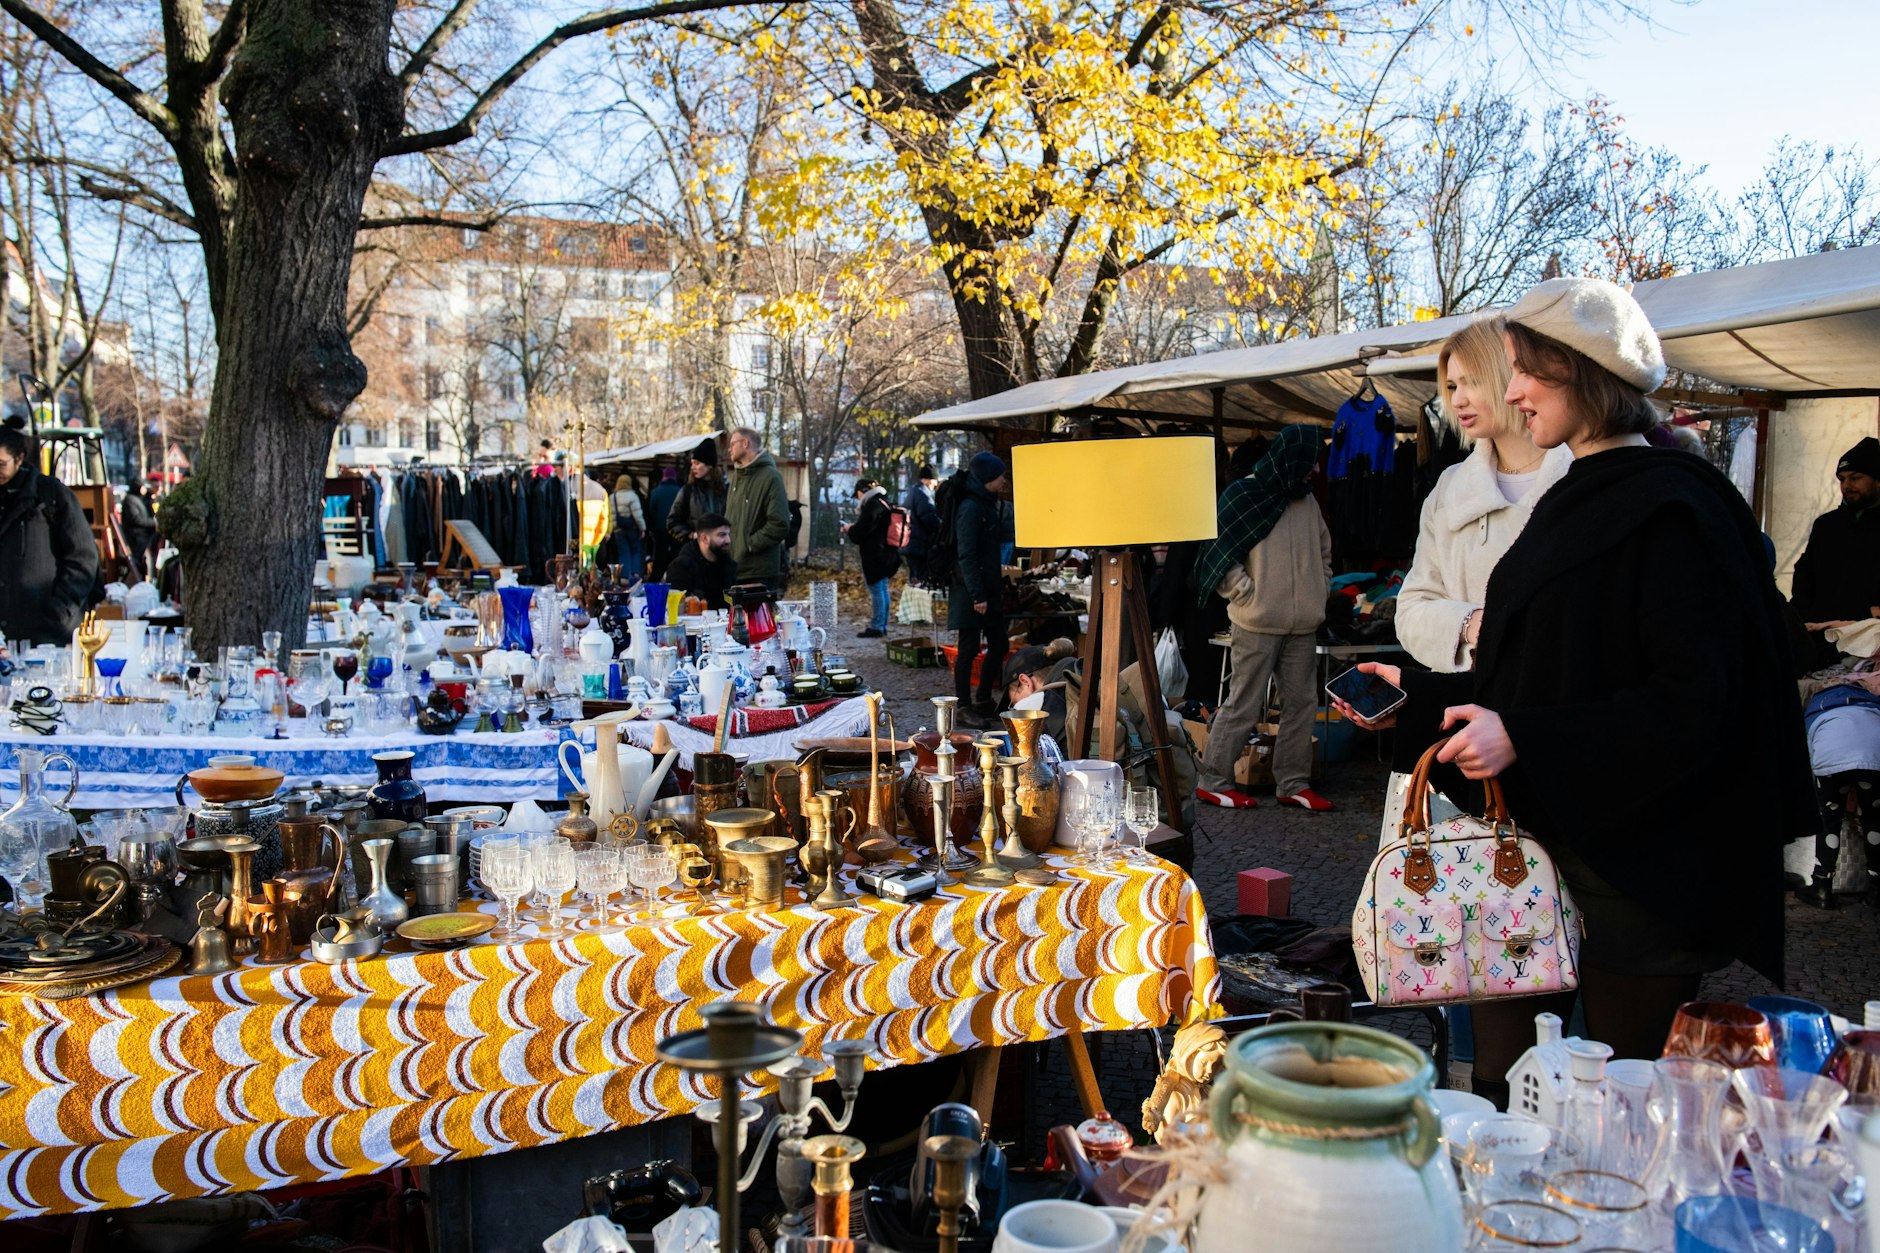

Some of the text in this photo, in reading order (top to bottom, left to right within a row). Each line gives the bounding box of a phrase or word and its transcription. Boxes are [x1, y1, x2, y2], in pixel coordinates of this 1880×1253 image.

[1455, 845, 1472, 864] LV
[1462, 902, 1480, 922] LV
[1509, 909, 1527, 928] LV
[1417, 915, 1435, 934] LV
[1511, 959, 1530, 979] LV
